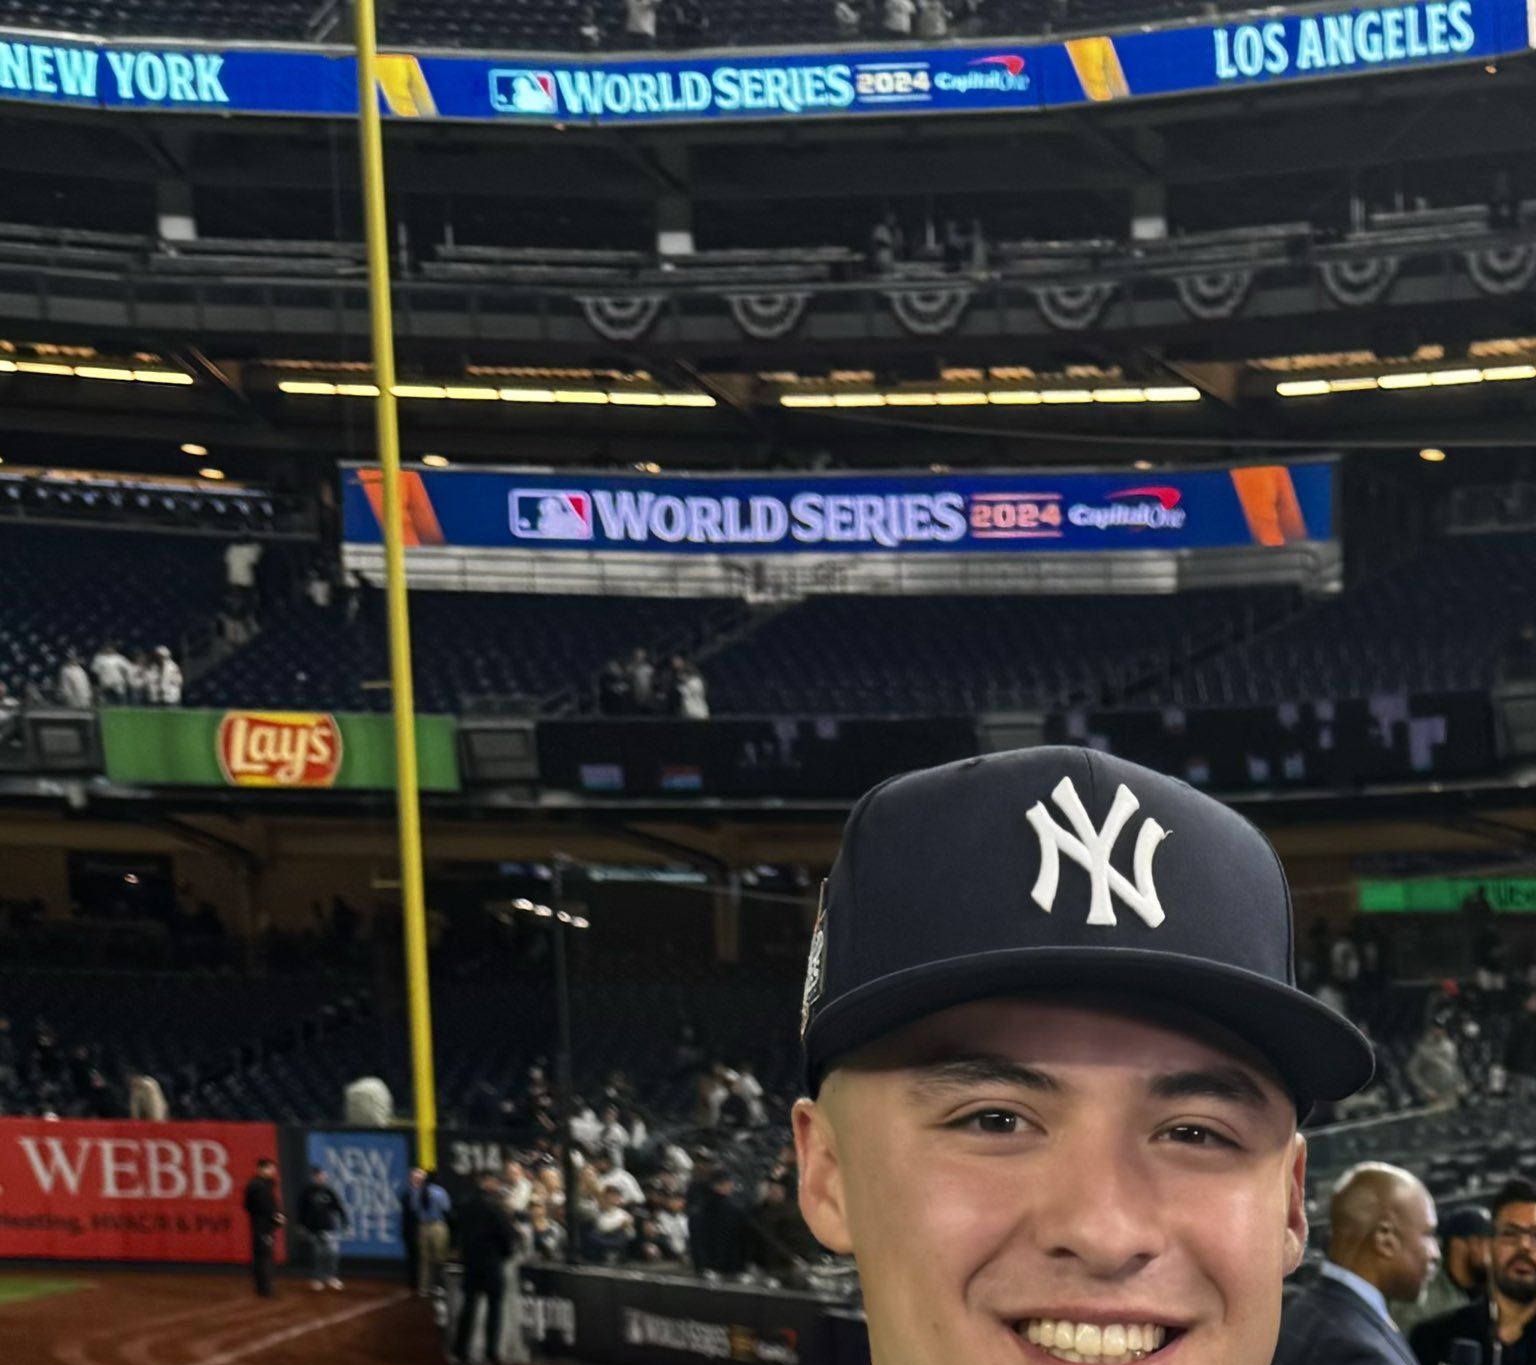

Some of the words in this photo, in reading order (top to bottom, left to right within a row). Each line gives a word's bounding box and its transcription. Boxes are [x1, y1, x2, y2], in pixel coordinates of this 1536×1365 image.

[1213, 23, 1288, 79] LOS
[1296, 0, 1475, 69] ANGELES
[0, 42, 99, 97] NEW
[106, 51, 230, 102] YORK
[553, 70, 712, 114] WORLD
[712, 64, 855, 112] SERIES
[857, 70, 931, 94] 2024
[592, 490, 788, 542] WORLD
[790, 492, 968, 547] SERIES
[970, 503, 1062, 528] 2024
[230, 718, 331, 783] Lay's
[1025, 775, 1167, 928] NY
[18, 1136, 233, 1200] WEBB
[324, 1146, 395, 1182] NEW
